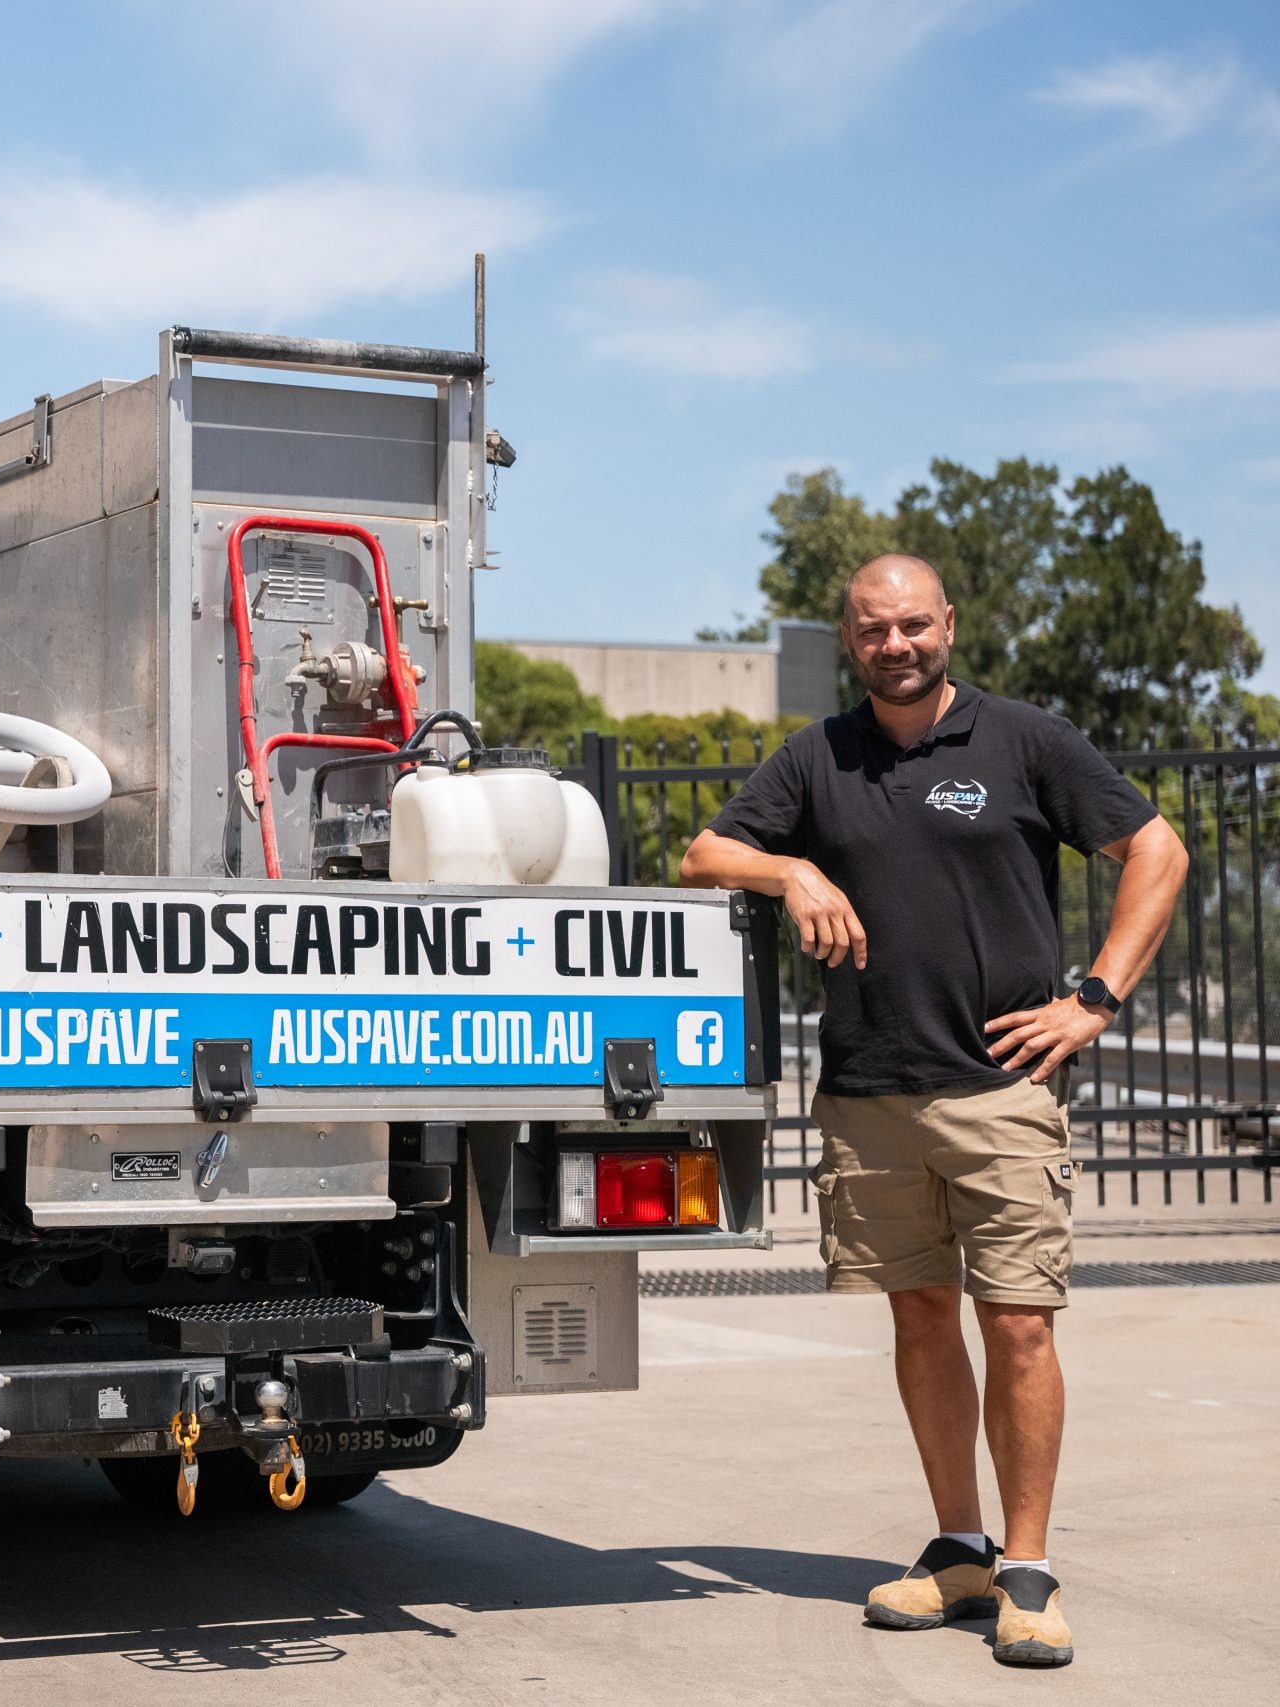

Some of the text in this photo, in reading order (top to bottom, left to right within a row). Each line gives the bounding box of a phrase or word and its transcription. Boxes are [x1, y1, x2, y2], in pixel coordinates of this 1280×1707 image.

[925, 791, 988, 802] AUSPAVE
[24, 900, 491, 977] LANDSCAPING
[554, 908, 699, 979] CIVIL
[268, 1008, 593, 1066] AUSPAVE.COM.AU
[299, 1432, 332, 1456] 02)
[338, 1429, 385, 1452] 9335
